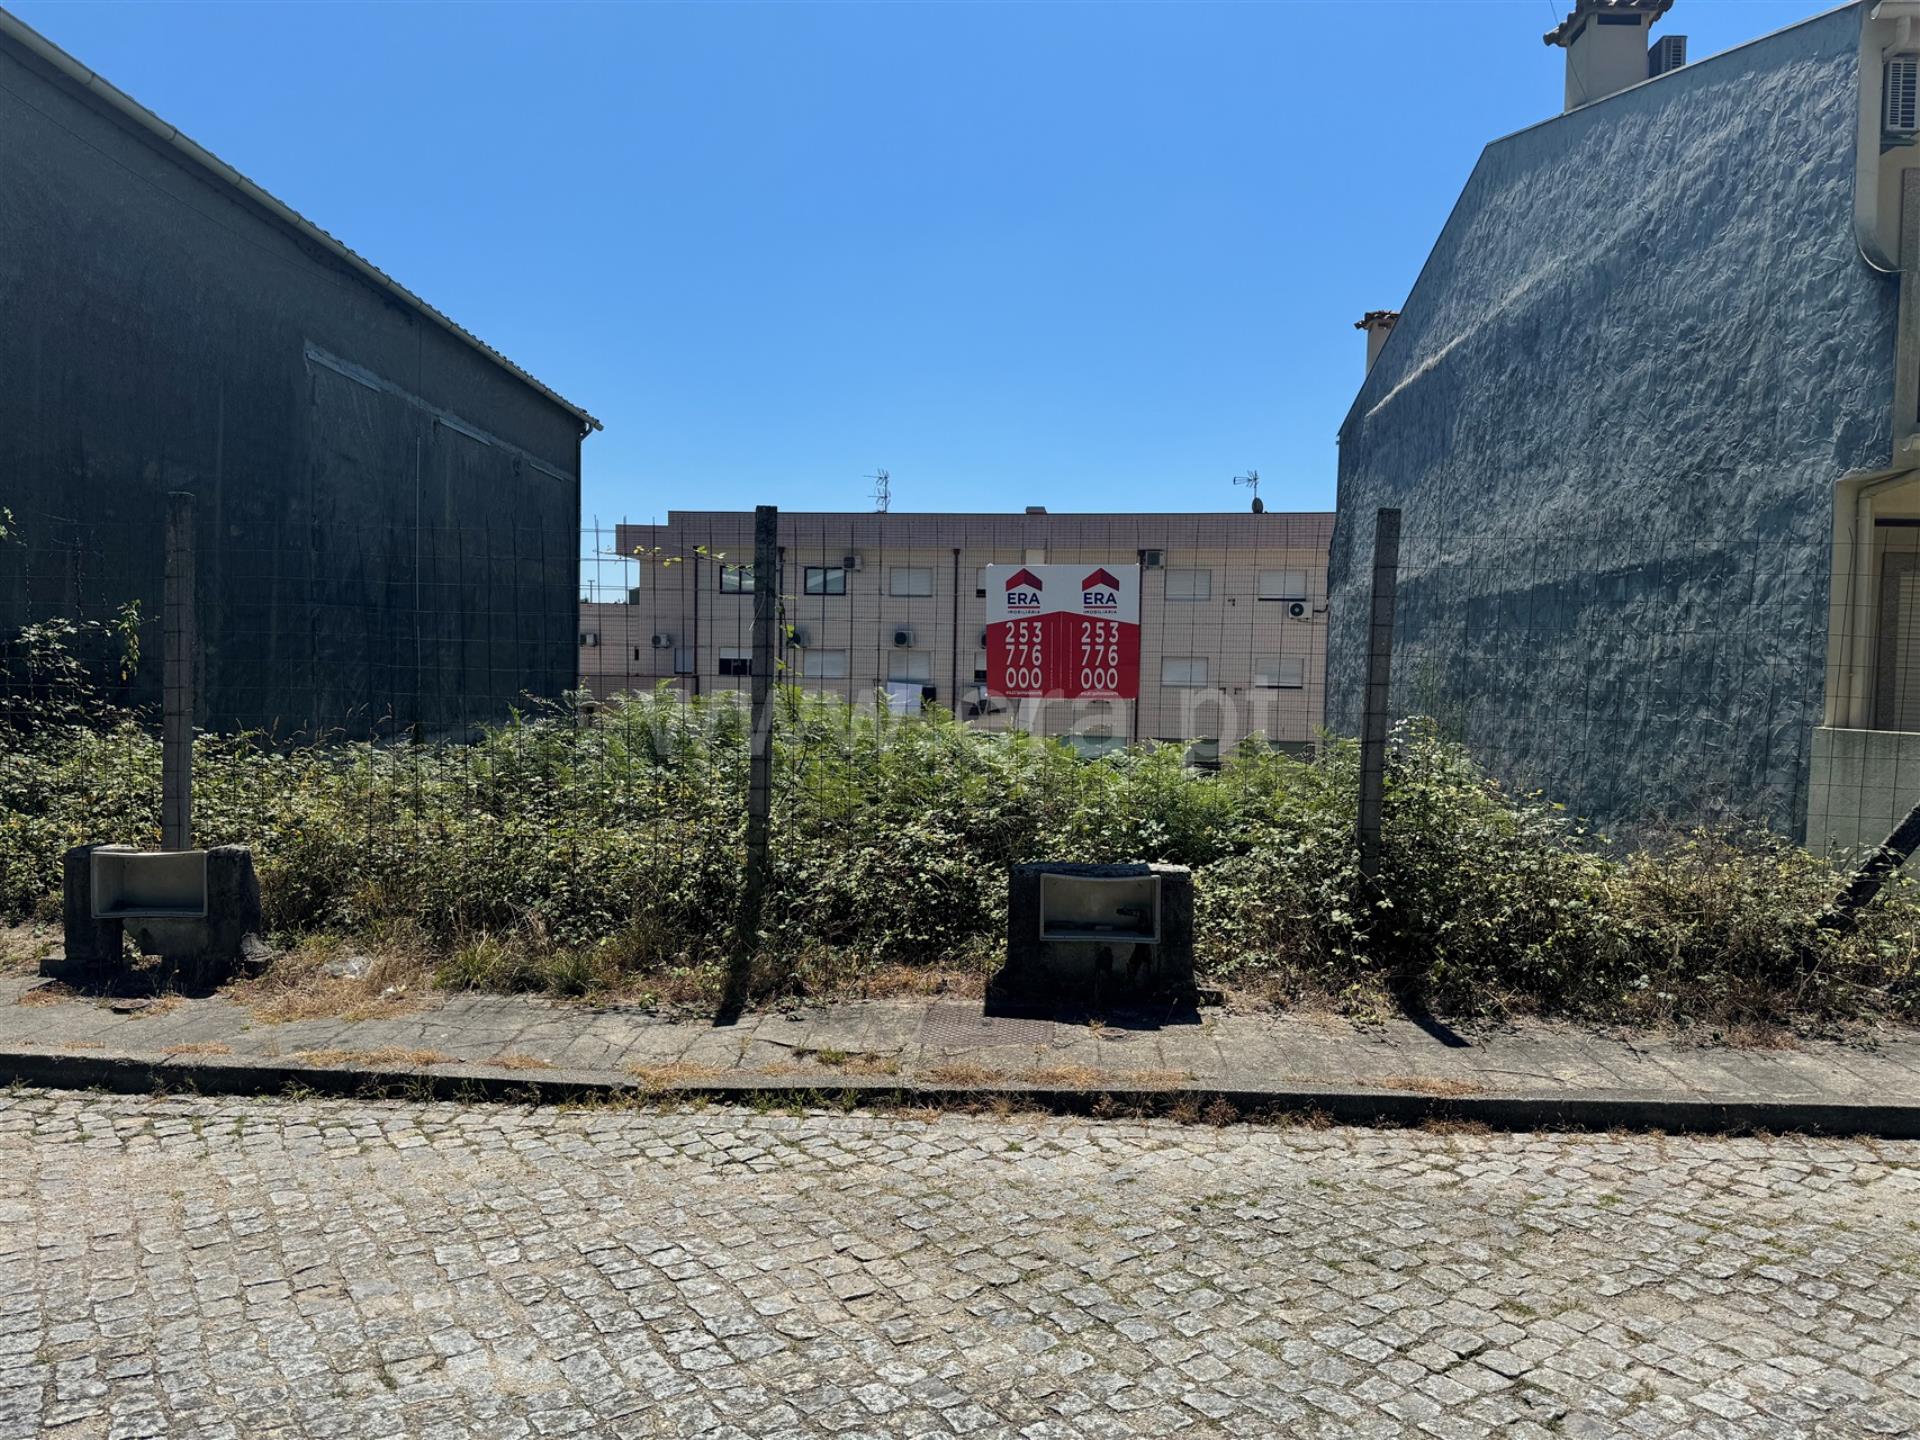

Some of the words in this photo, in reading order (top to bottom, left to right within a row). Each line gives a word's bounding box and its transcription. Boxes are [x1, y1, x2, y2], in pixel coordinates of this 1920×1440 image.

[1007, 592, 1040, 605] ERA
[1083, 592, 1117, 605] ERA
[1005, 621, 1043, 643] 253
[1081, 621, 1119, 643] 253
[1005, 645, 1043, 666] 776
[1081, 645, 1119, 666] 776
[1005, 667, 1043, 689] 000
[1081, 667, 1119, 689] 000
